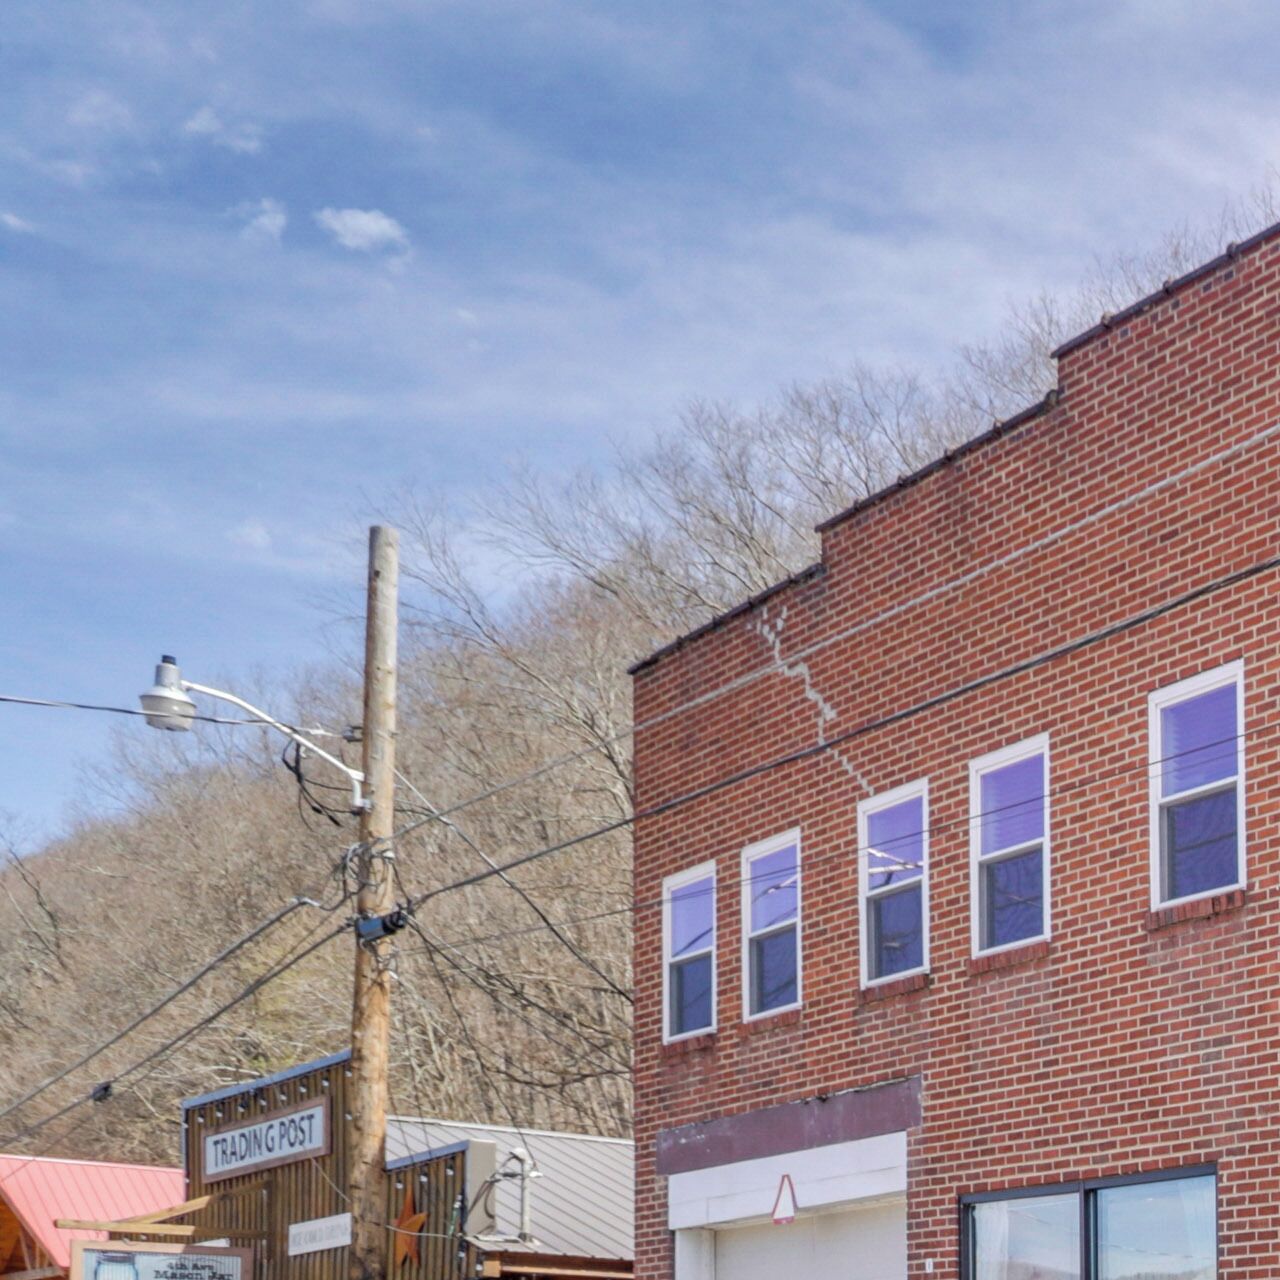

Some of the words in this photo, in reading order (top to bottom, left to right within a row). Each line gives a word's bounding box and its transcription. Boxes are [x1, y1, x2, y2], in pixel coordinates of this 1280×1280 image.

[213, 1123, 275, 1168] TRADING
[279, 1113, 315, 1150] POST
[154, 1270, 204, 1280] Mason
[208, 1271, 234, 1280] Jar
